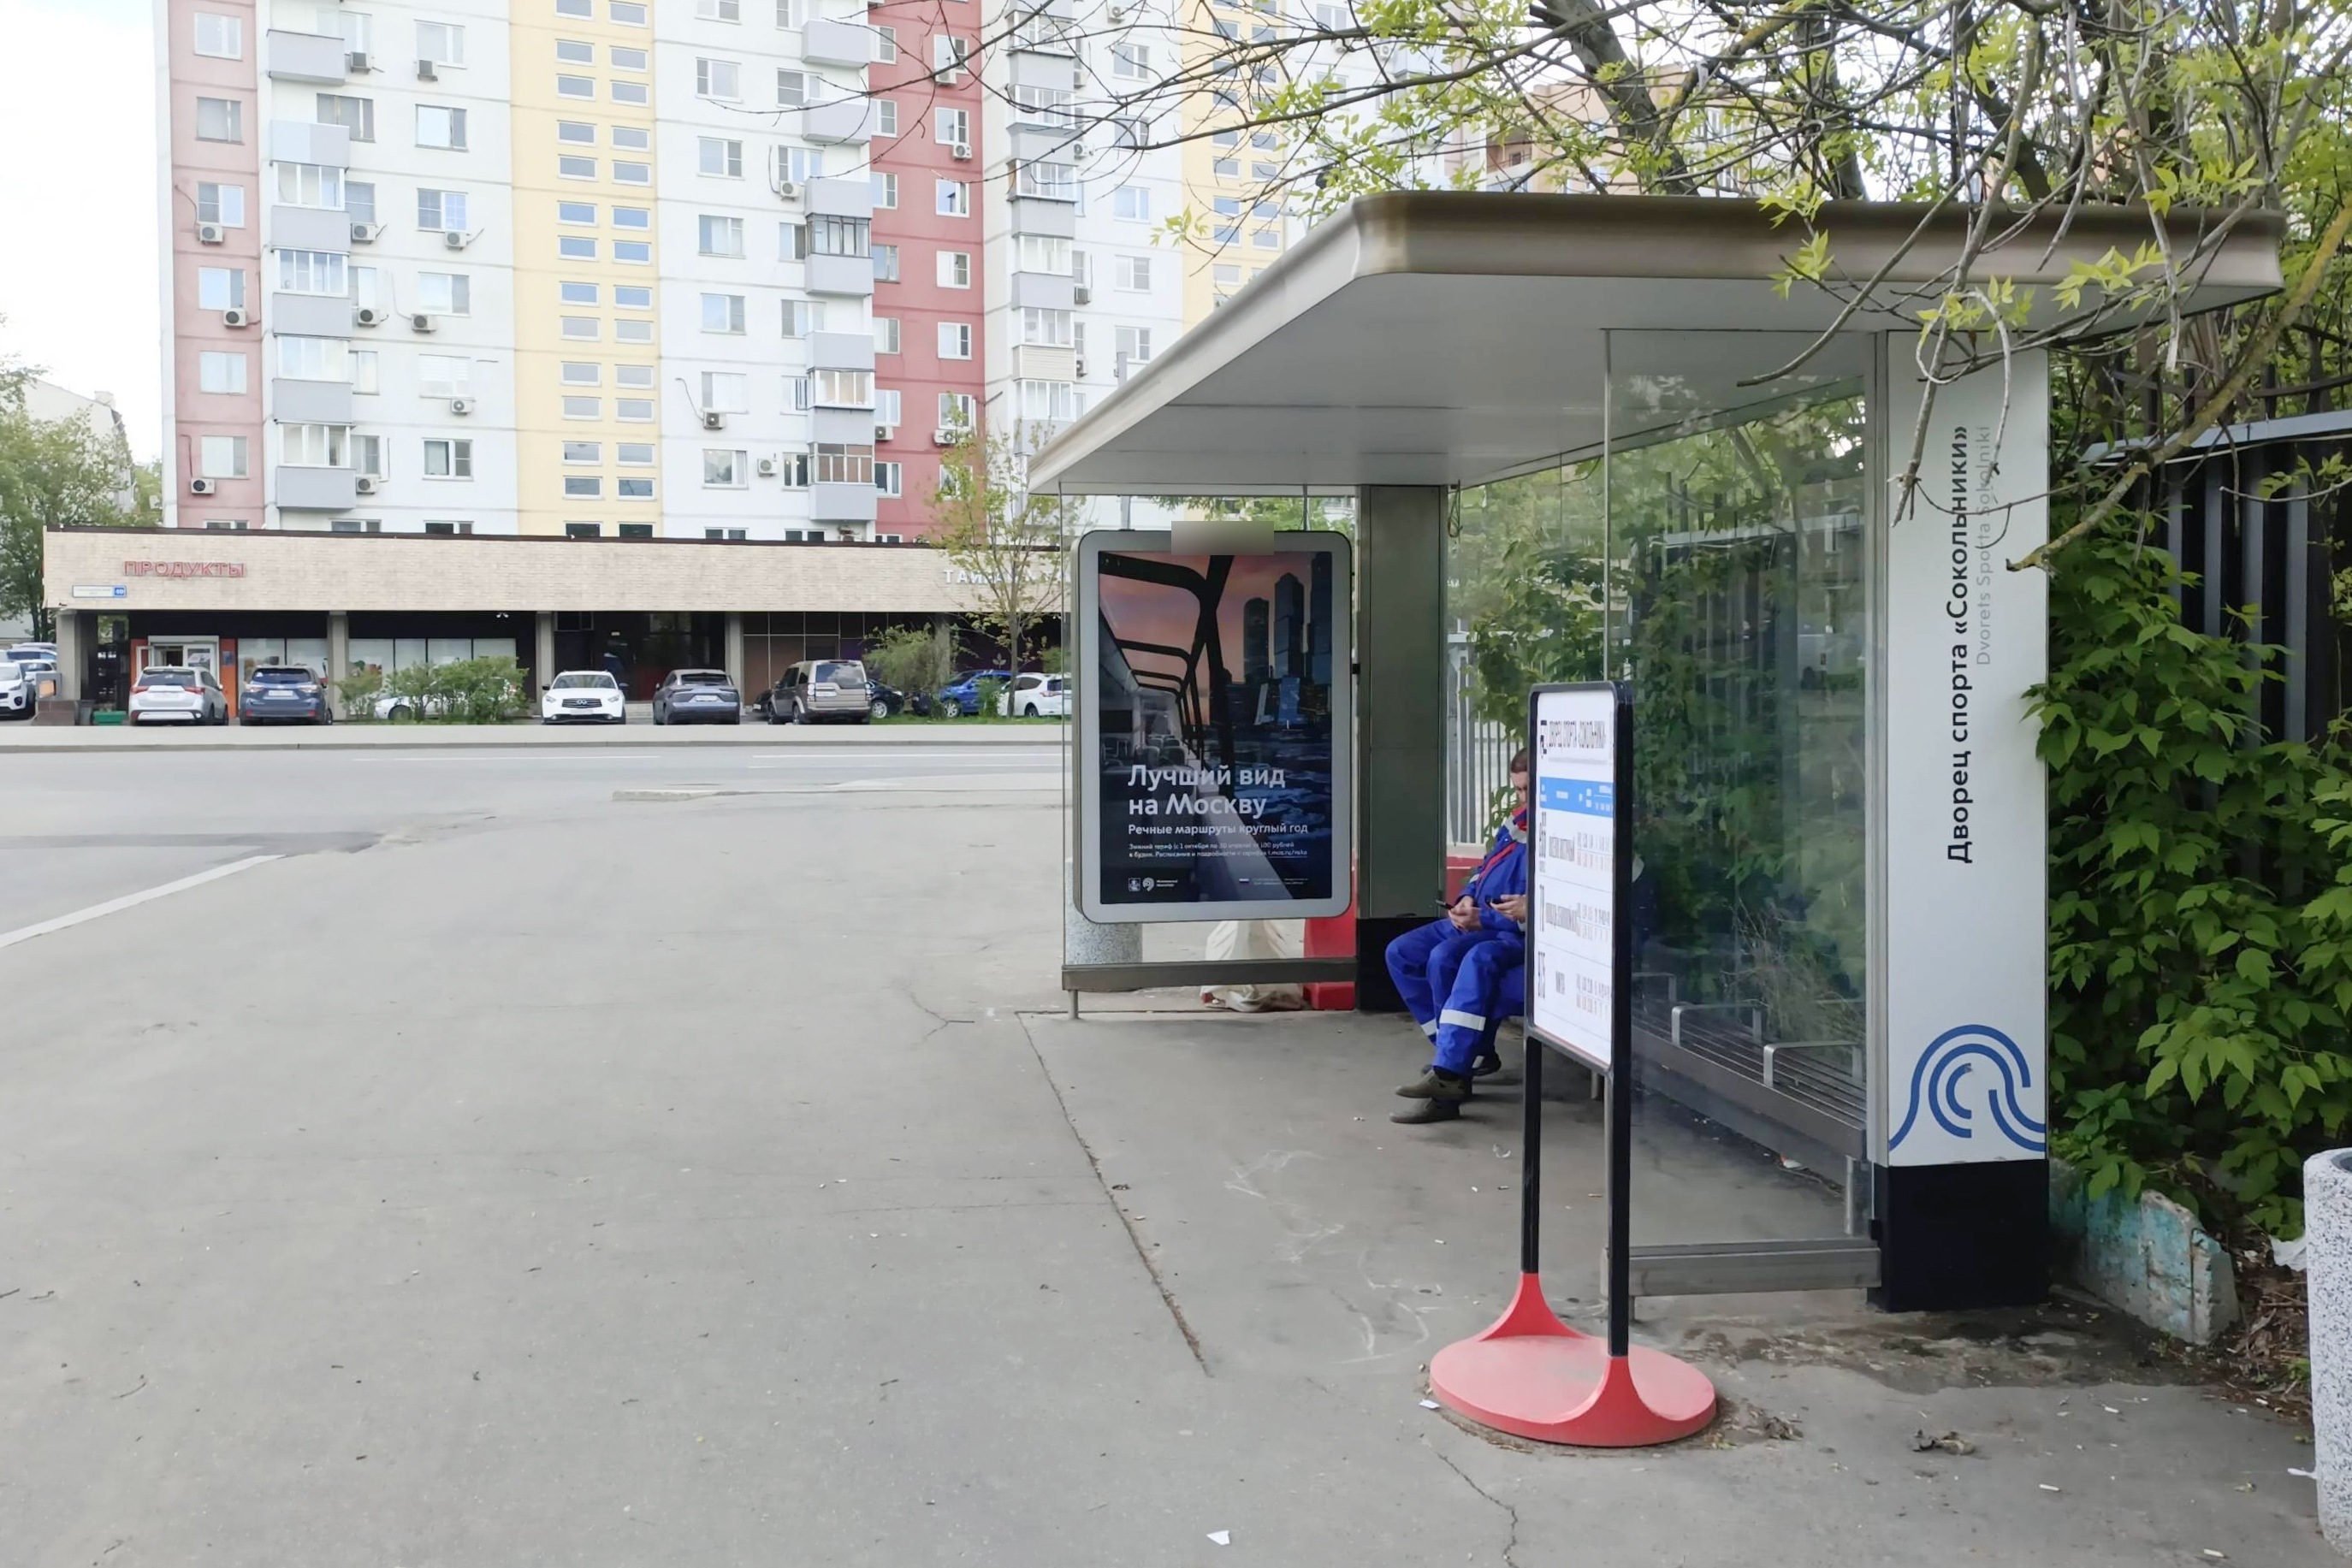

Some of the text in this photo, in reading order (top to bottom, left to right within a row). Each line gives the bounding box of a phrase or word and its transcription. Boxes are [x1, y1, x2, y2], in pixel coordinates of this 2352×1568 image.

[124, 561, 246, 578] ПРОДУКТЫ
[1976, 592, 1992, 665] Dvorets
[1946, 426, 1974, 864] Дворец спорта «Сокольники»
[1128, 764, 1286, 791] Лучший вид
[1129, 793, 1267, 820] на Москву
[1128, 823, 1309, 836] Речные маршруты круглый год
